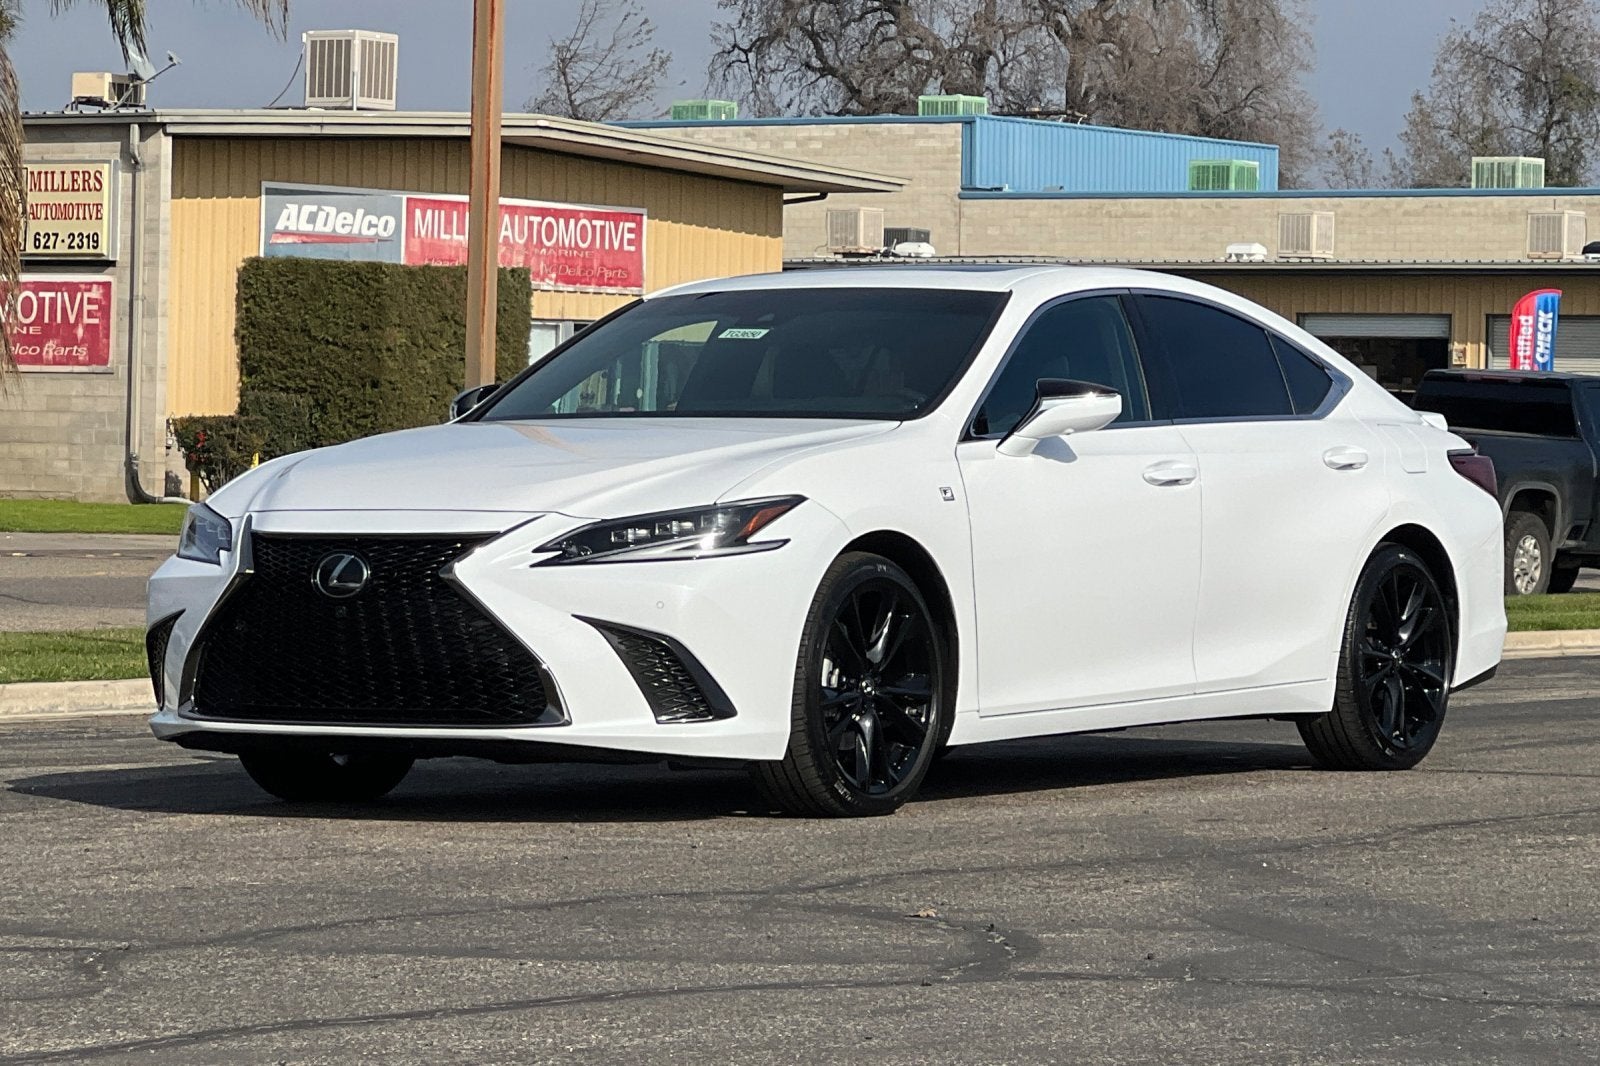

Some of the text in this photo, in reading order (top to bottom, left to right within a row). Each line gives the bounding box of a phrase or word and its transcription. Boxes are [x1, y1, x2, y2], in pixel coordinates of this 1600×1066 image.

[29, 170, 103, 192] MILLERS
[29, 202, 103, 221] AUTOMOTIVE
[275, 203, 396, 237] ACDelco
[499, 214, 636, 251] AUTOMOTIVE
[596, 265, 628, 279] Parts
[1535, 310, 1553, 364] CHECK
[43, 342, 88, 357] Parts
